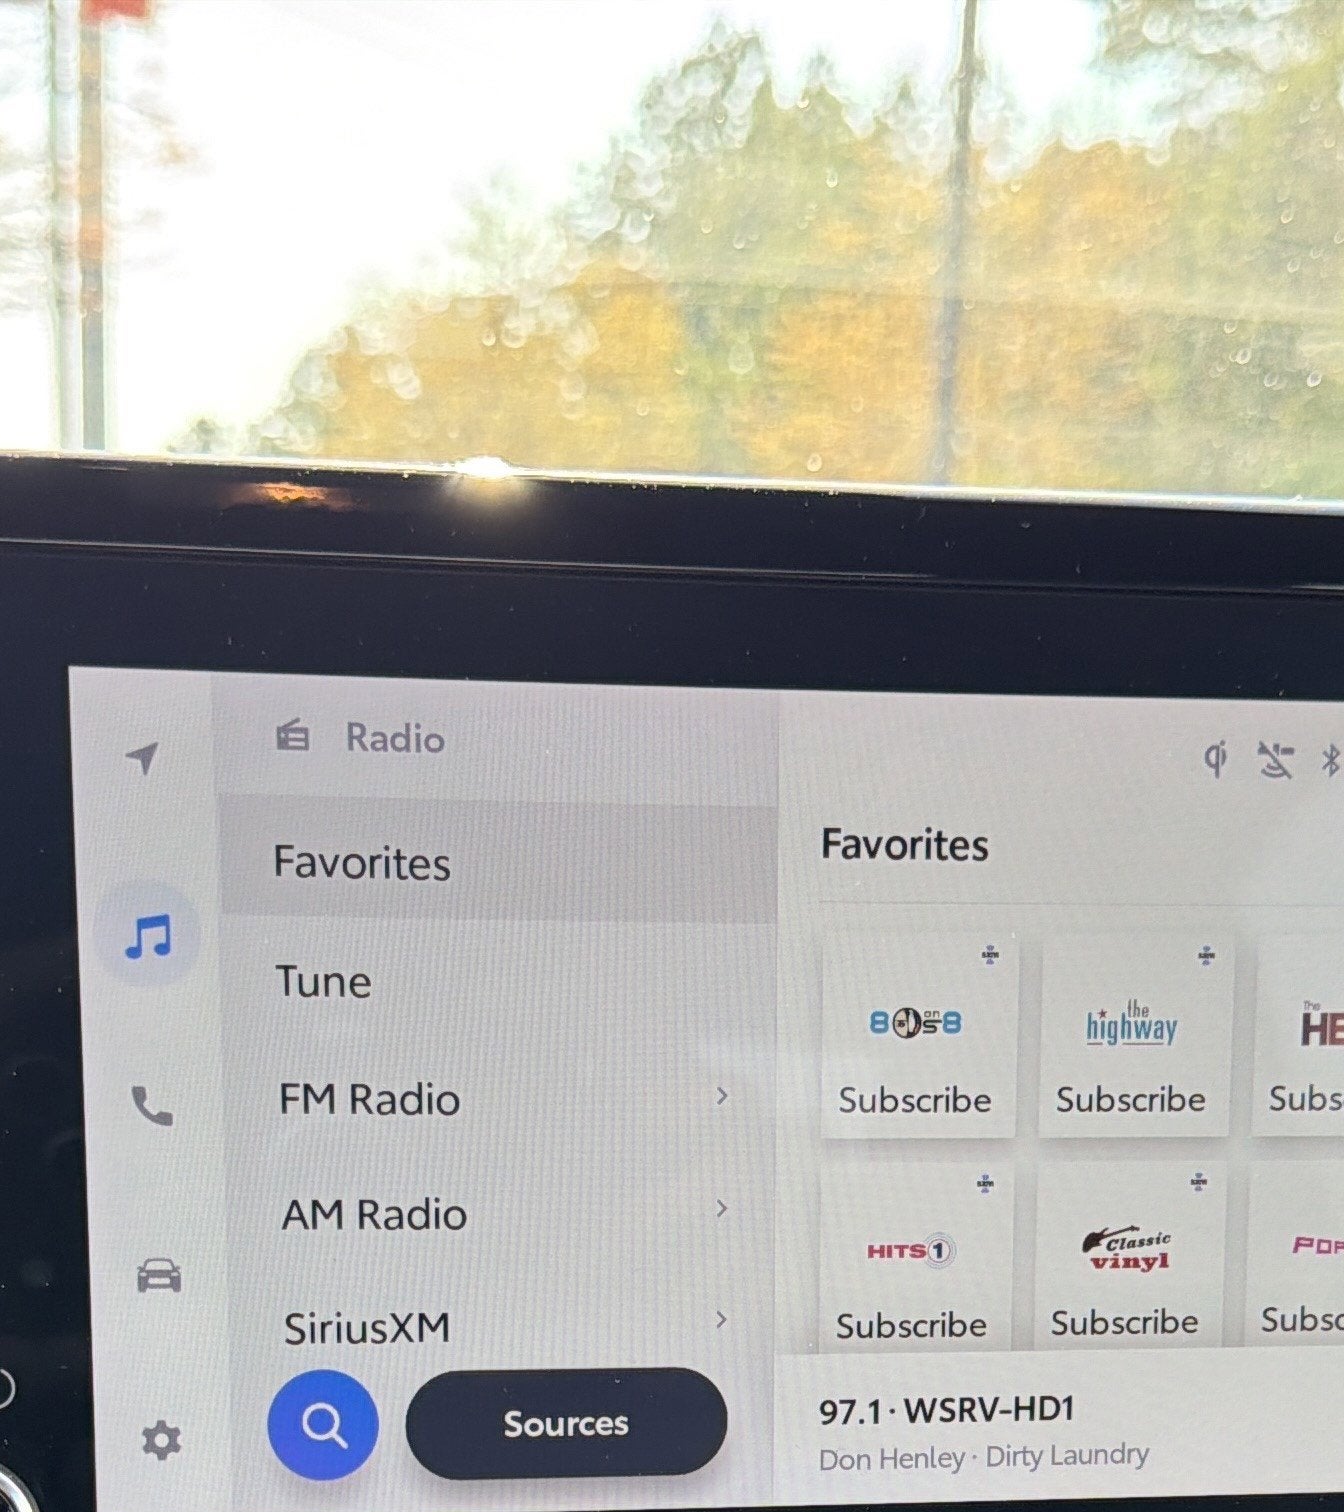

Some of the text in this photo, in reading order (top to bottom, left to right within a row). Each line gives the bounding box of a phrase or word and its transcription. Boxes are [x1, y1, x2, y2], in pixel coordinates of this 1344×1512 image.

[347, 721, 446, 754] Radio
[821, 827, 990, 862] Favorites
[273, 844, 452, 882] Favorites
[275, 964, 373, 999] Tune
[1126, 998, 1150, 1018] the
[1086, 1011, 1178, 1046] highway
[280, 1081, 461, 1117] FM Radio
[838, 1086, 993, 1115] Subscribe
[1056, 1086, 1206, 1115] Subscribe
[282, 1197, 468, 1232] AM Radio
[867, 1242, 943, 1259] HITS 1
[1106, 1231, 1172, 1251] Classic
[1090, 1252, 1170, 1273] vinyl
[283, 1310, 451, 1346] SiriusXM
[836, 1312, 987, 1341] Subscribe
[1051, 1309, 1200, 1338] Subscribe
[503, 1410, 630, 1440] Sources
[819, 1394, 1076, 1427] 97.1 WSRV-HD1
[819, 1441, 1151, 1474] Don Henley Dirty Laundry
